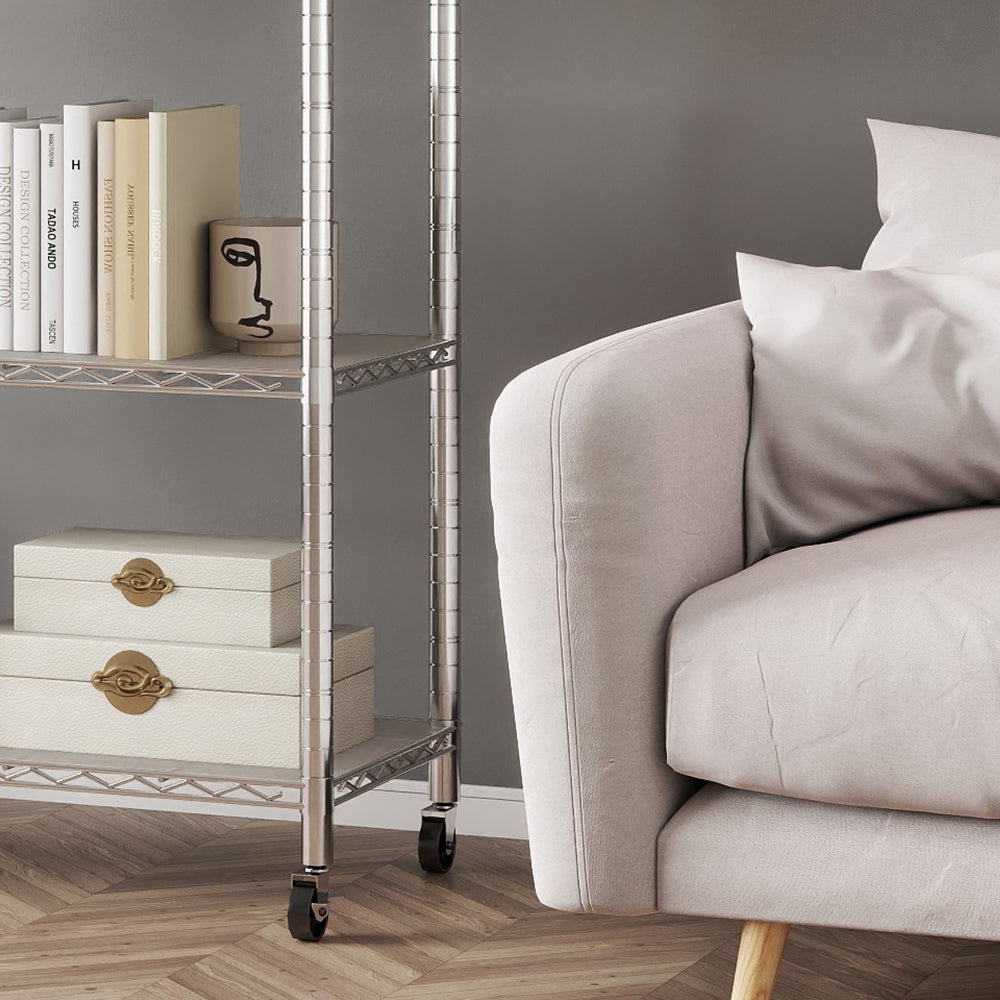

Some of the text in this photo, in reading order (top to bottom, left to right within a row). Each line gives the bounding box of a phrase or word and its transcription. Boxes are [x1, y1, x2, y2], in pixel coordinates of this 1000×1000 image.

[71, 159, 81, 170] H
[20, 169, 30, 311] DESIGN COLLECTION
[47, 208, 57, 270] TADAO ANDO
